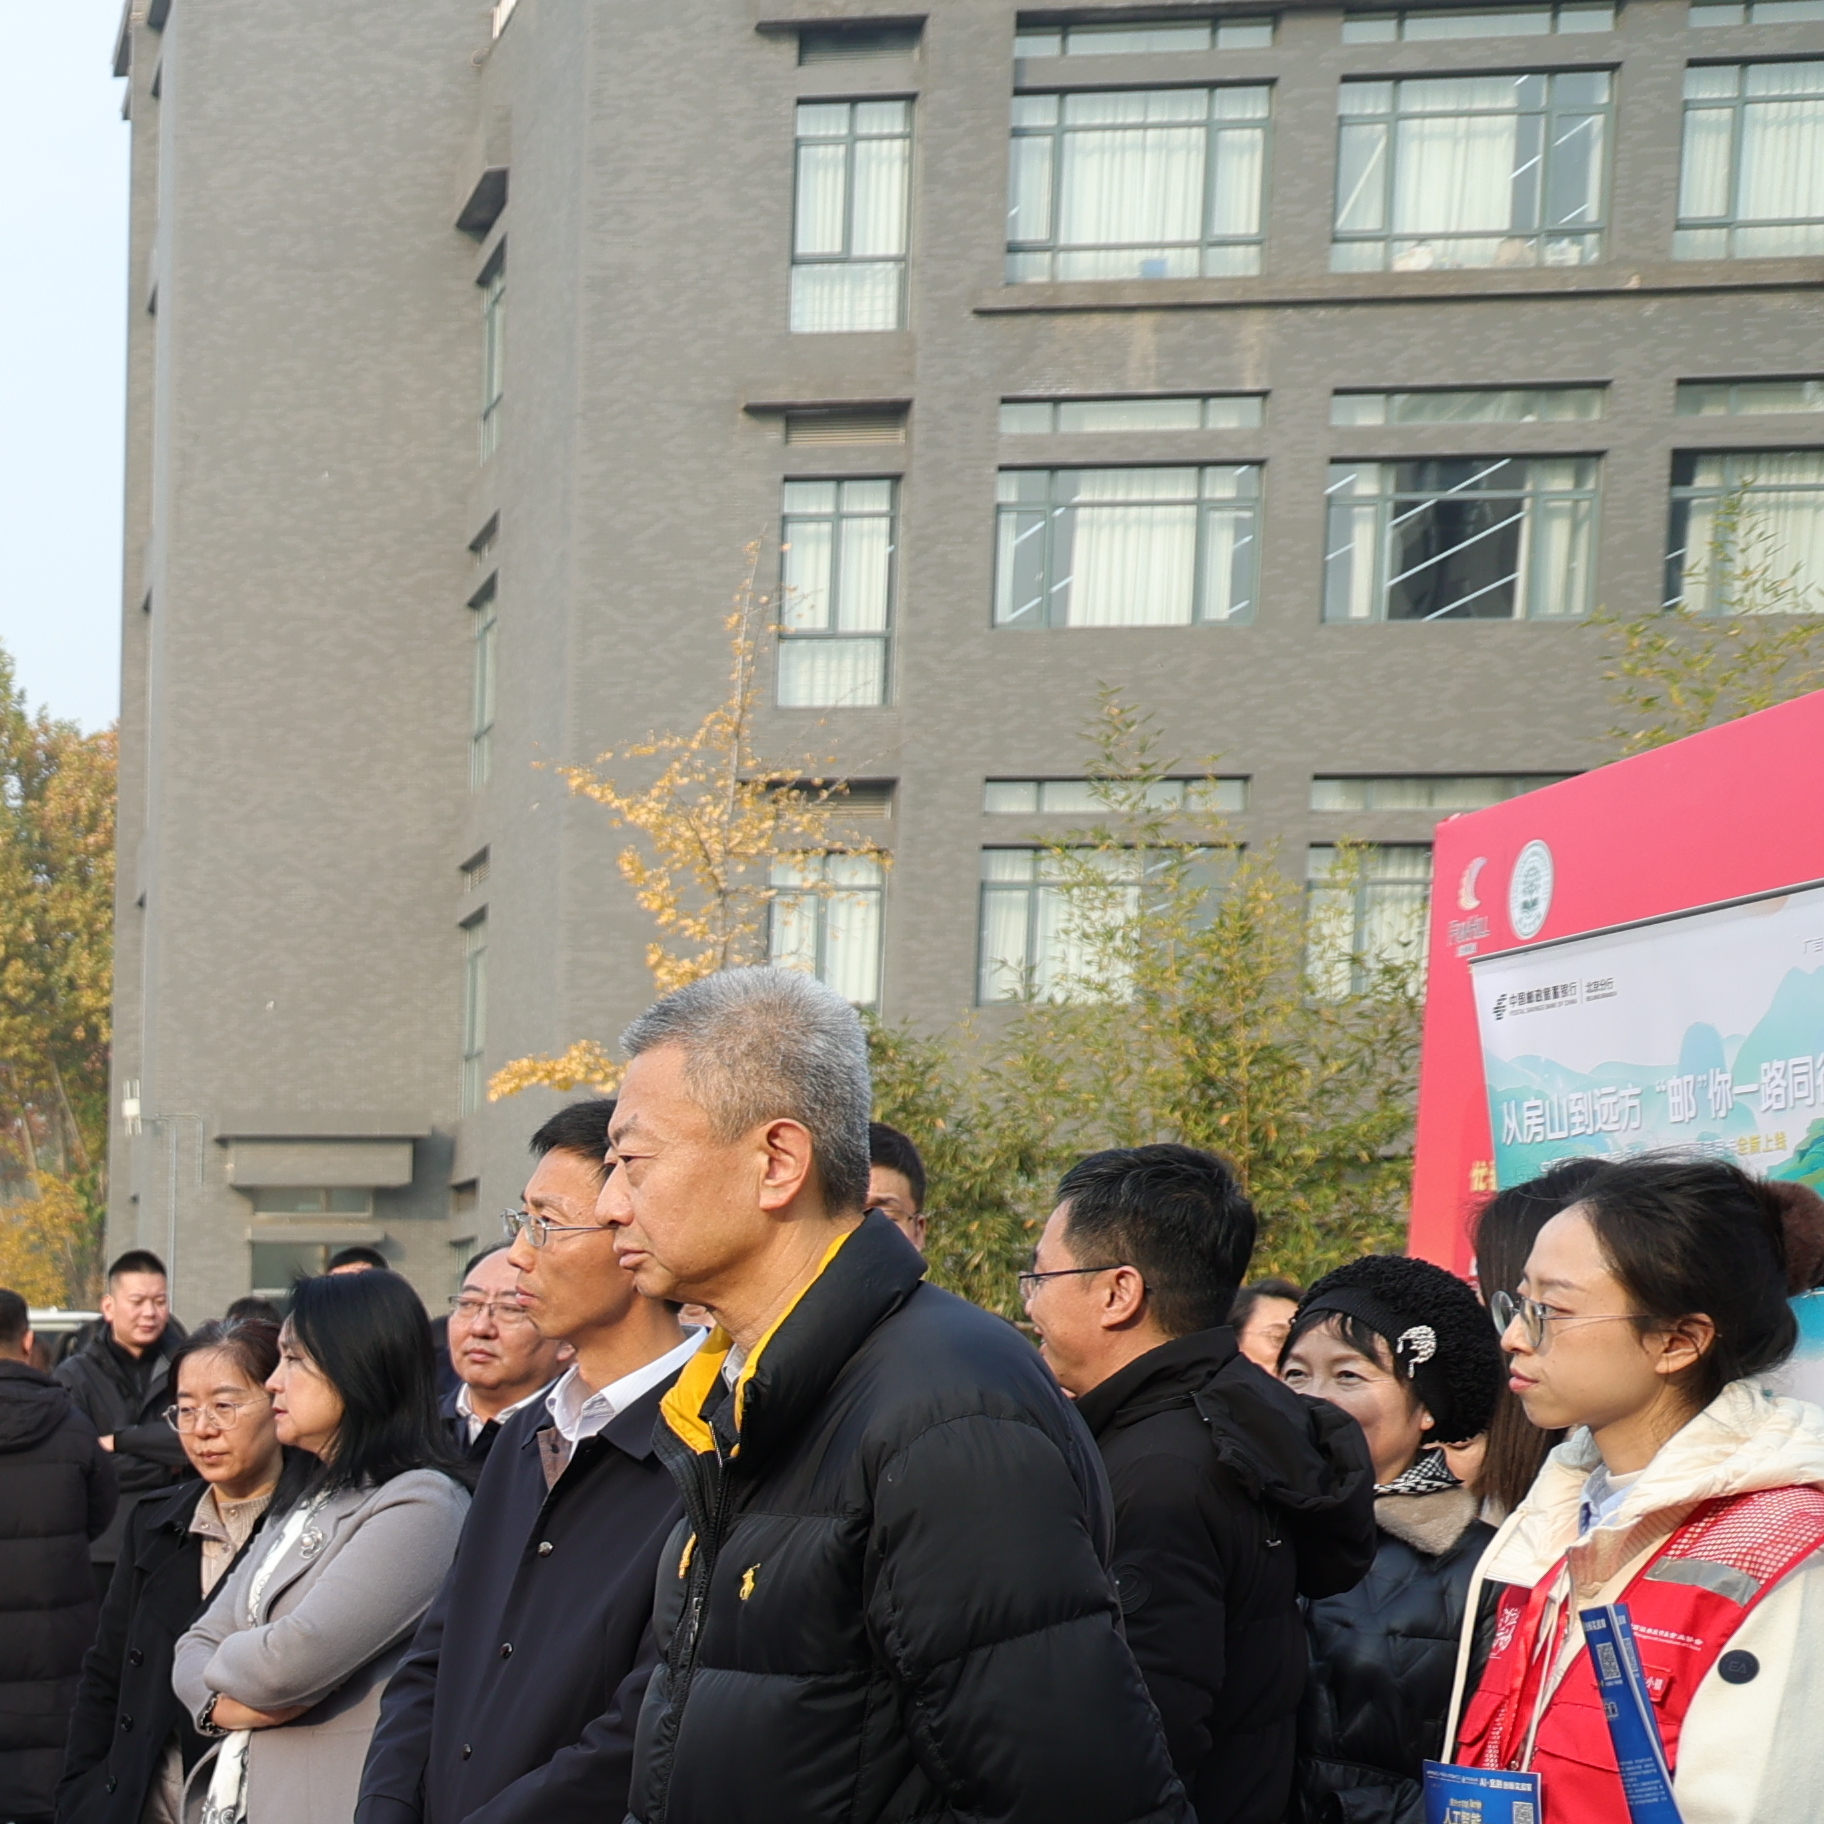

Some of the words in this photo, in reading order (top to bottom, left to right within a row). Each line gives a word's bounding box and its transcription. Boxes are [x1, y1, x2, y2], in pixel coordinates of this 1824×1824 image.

[1503, 1084, 1642, 1146] 从房山到远方
